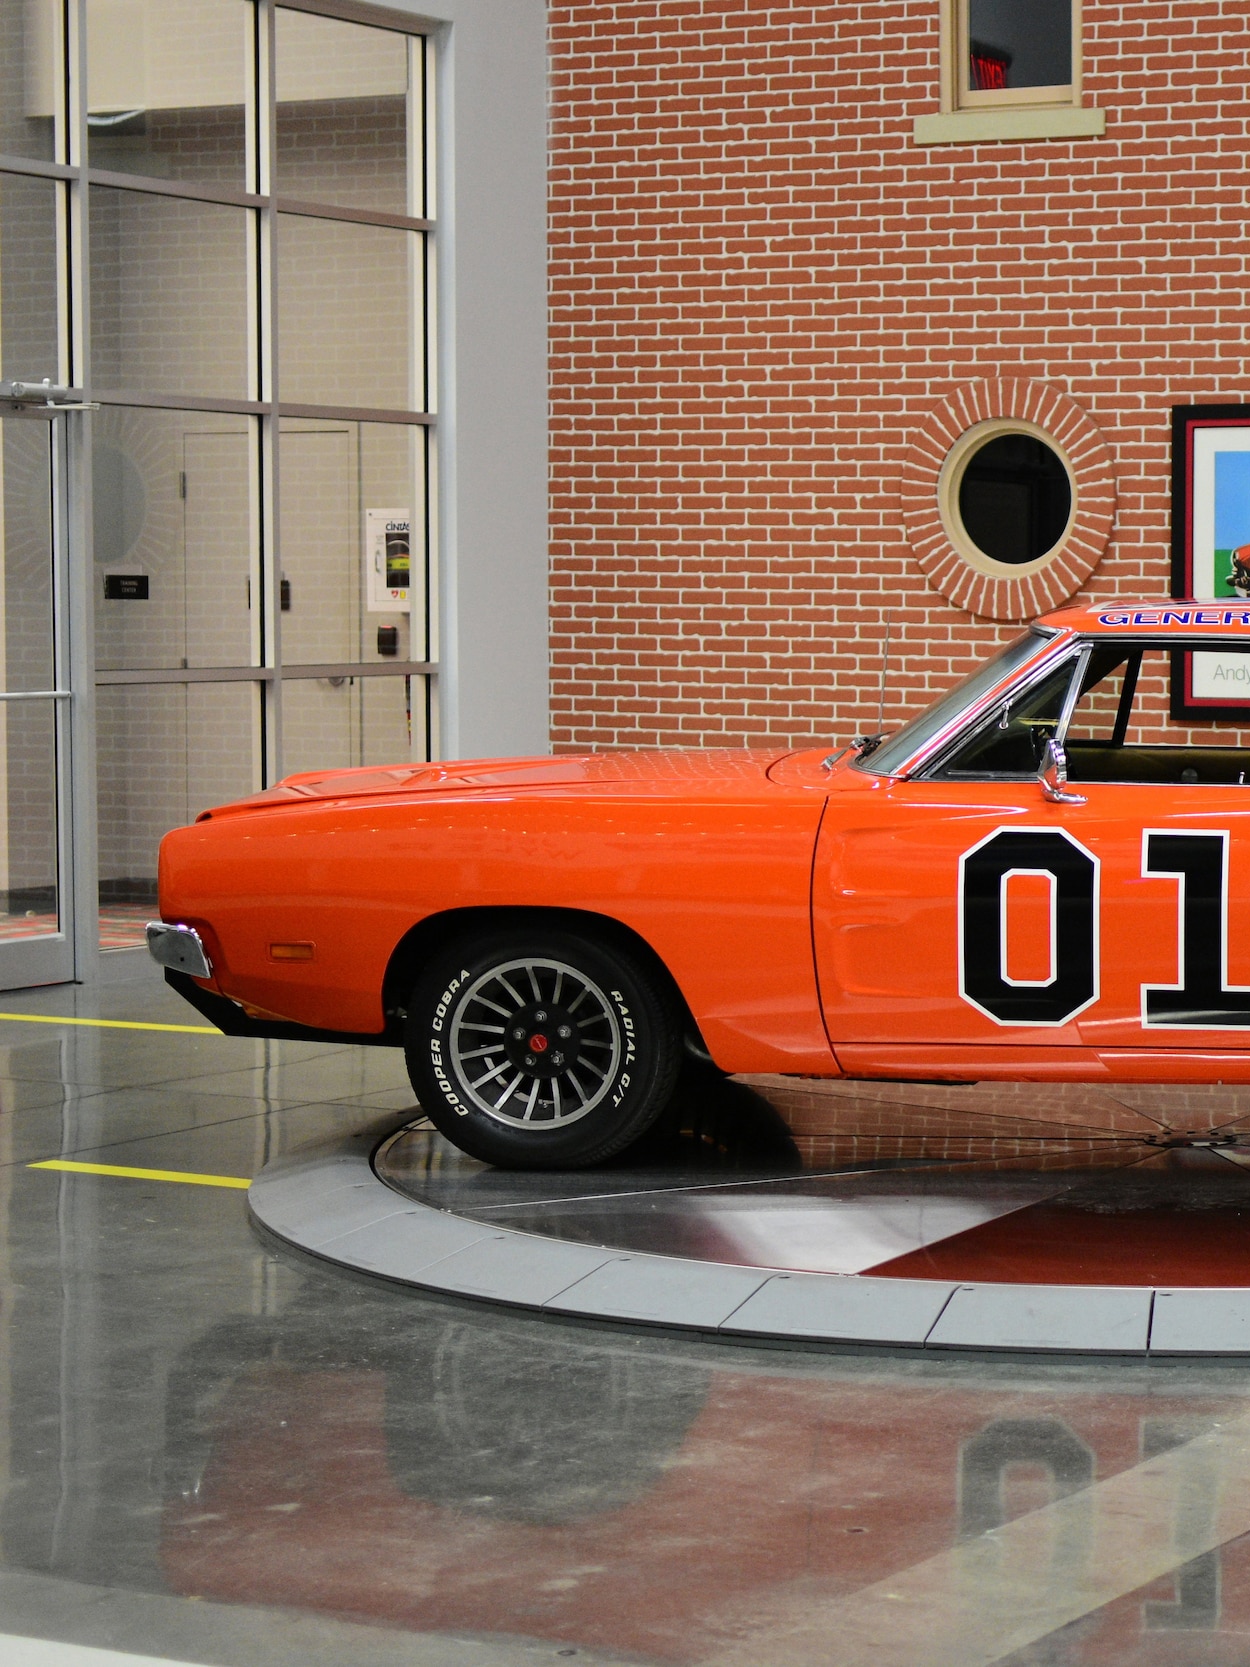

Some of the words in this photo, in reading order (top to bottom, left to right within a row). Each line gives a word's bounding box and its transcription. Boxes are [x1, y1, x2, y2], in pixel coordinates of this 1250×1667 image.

[432, 969, 471, 1032] COBRA
[610, 990, 636, 1065] RADIAL
[430, 1038, 469, 1117] COOPER
[612, 1072, 631, 1108] G/T
